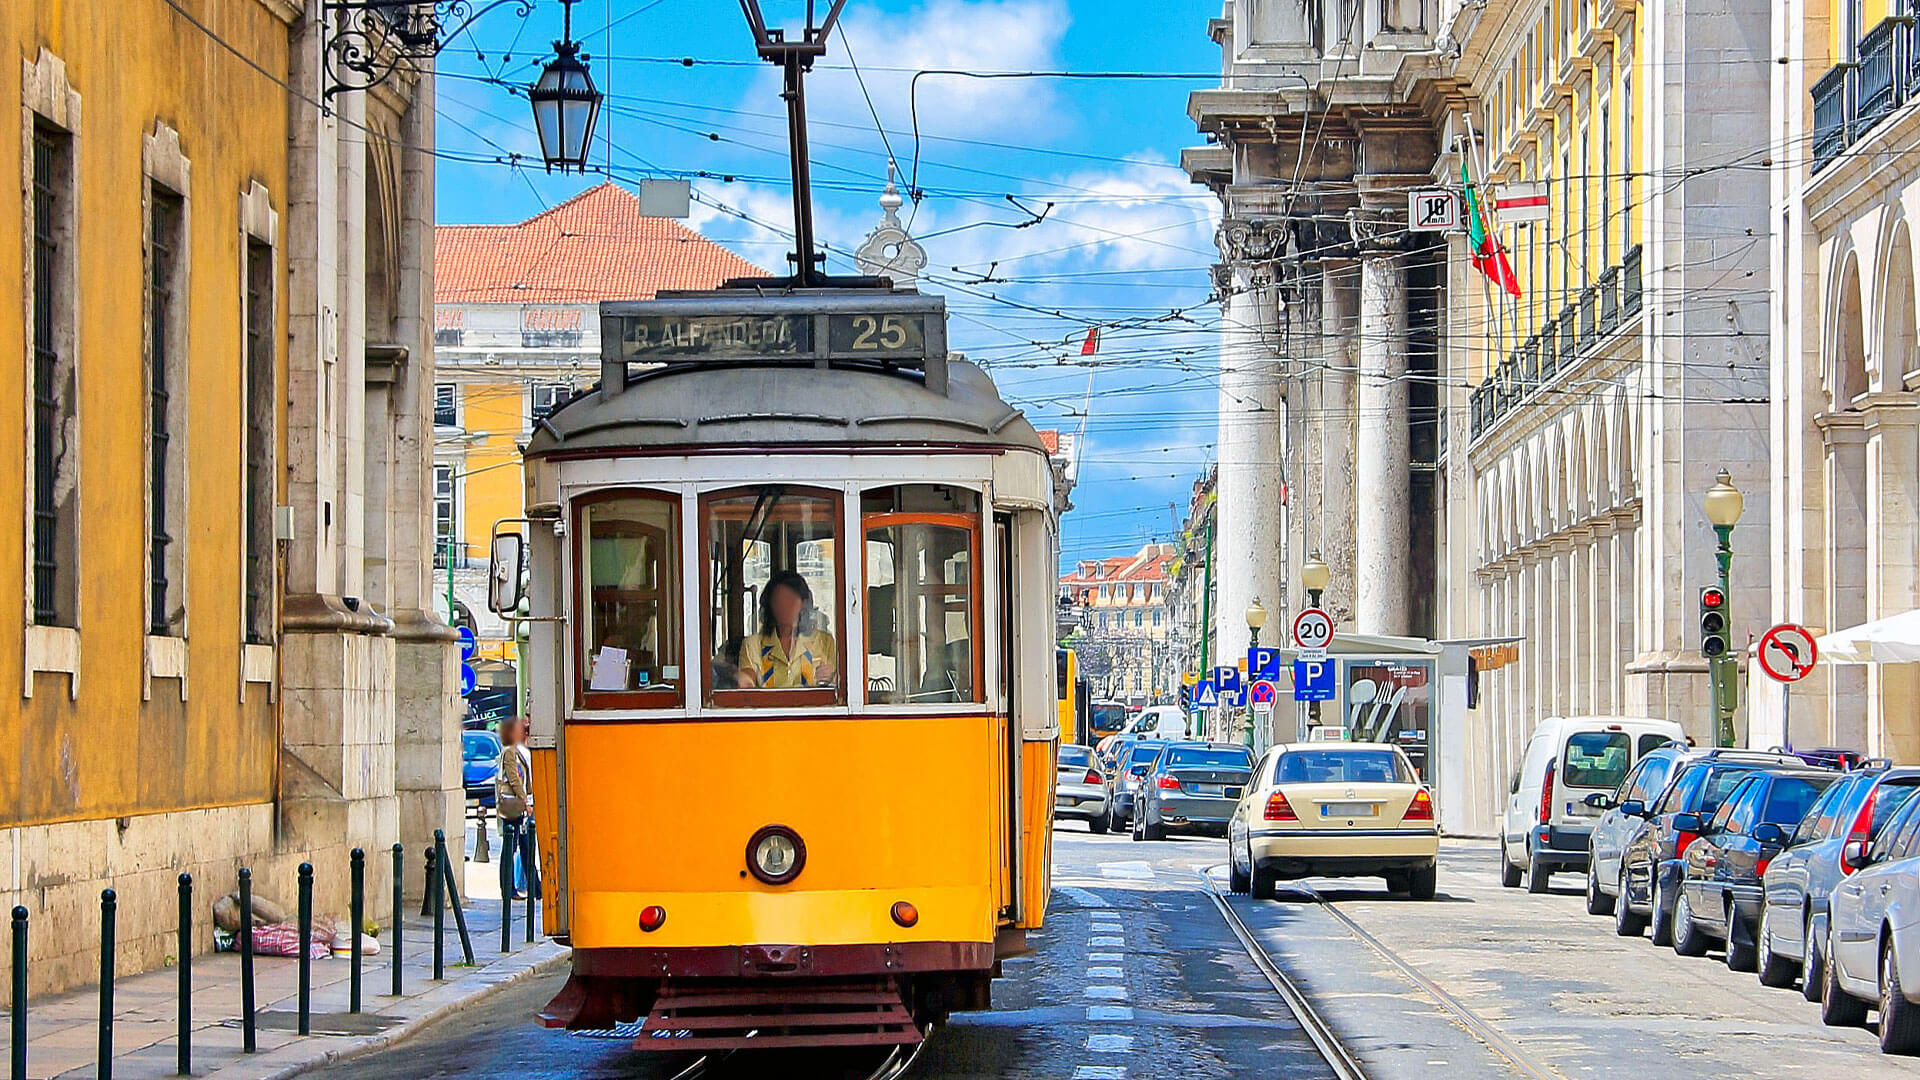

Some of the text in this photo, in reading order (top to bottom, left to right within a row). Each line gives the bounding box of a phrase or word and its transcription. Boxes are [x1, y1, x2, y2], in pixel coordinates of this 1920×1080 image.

[852, 315, 906, 349] 25
[1300, 622, 1327, 639] 20
[1257, 651, 1271, 672] P
[1219, 667, 1235, 687] P
[1306, 661, 1323, 687] P
